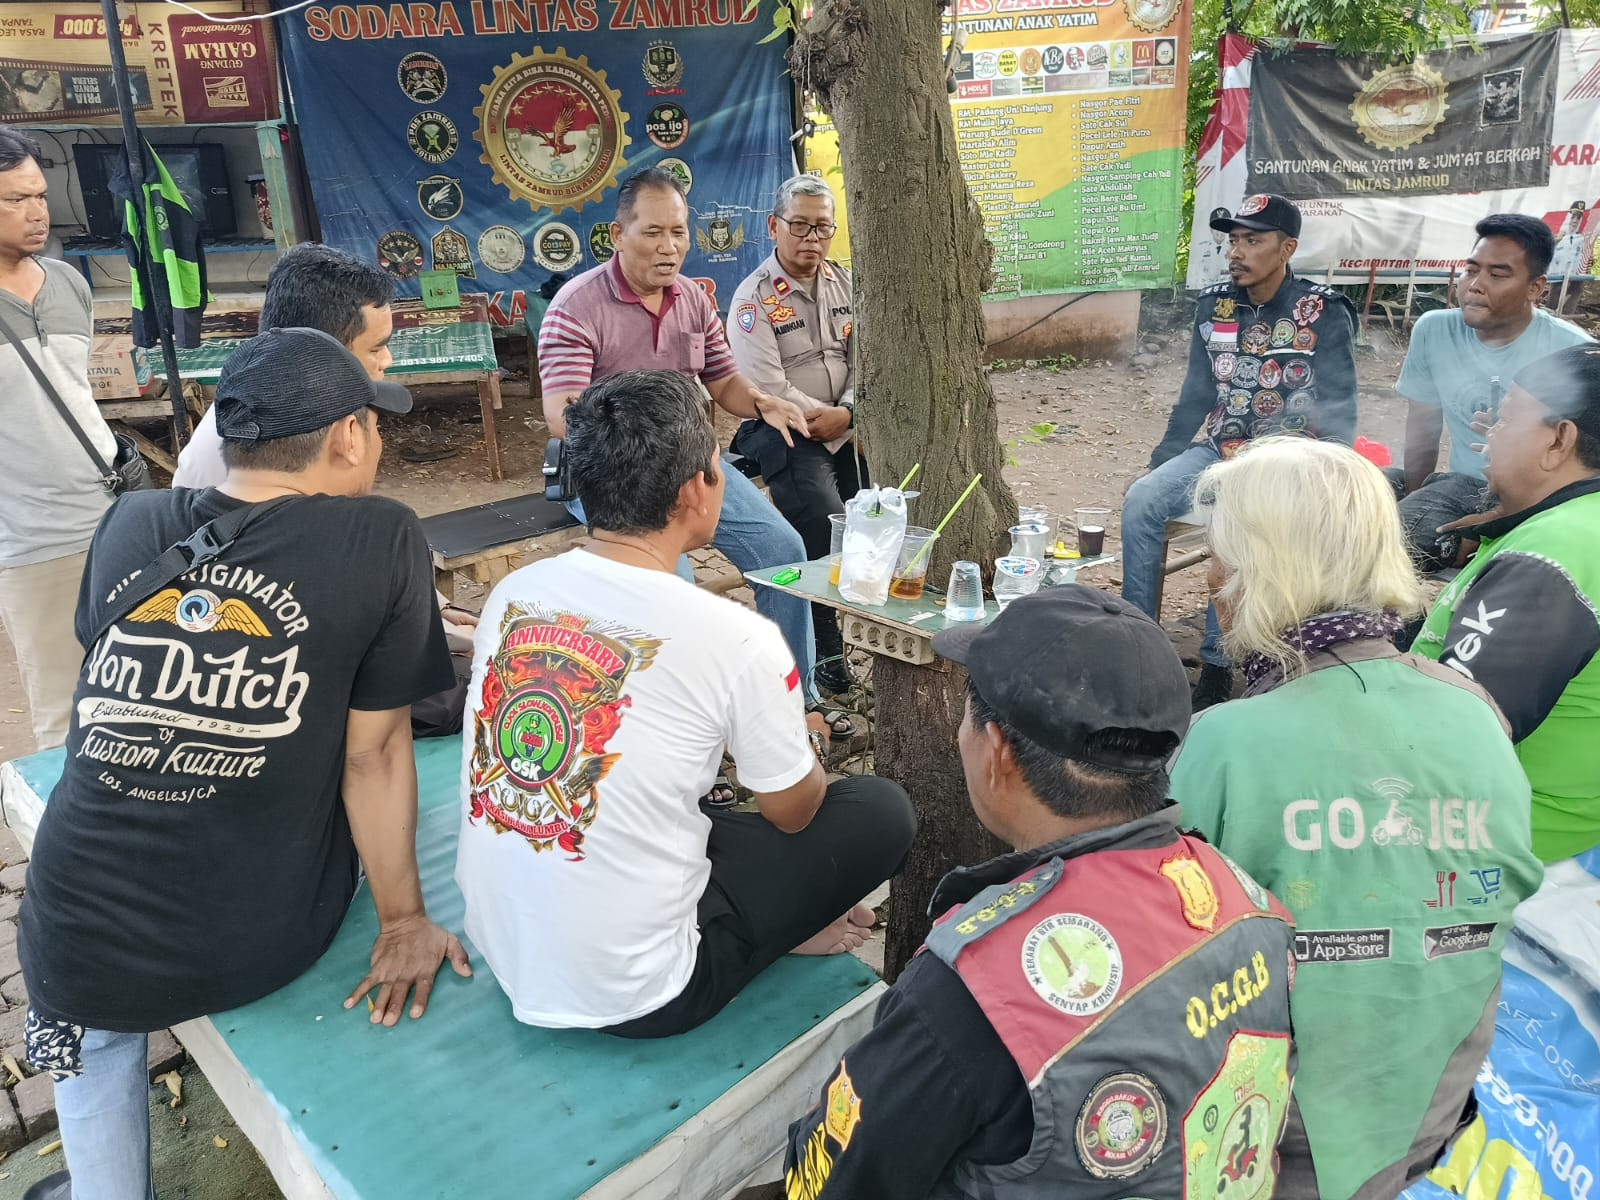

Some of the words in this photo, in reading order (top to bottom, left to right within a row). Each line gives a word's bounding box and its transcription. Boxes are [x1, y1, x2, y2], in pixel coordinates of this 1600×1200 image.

[2, 18, 34, 27] TANPA
[304, 2, 464, 41] SODARA
[472, 0, 599, 35] LINTAS
[608, 0, 758, 29] ZAMRUD
[1016, 15, 1055, 30] ANAK
[1056, 12, 1098, 28] YATIM
[20, 28, 45, 36] RASA
[181, 23, 253, 38] International
[183, 42, 257, 60] GARAM
[148, 23, 179, 118] KRETEK
[200, 60, 243, 68] GUDANG
[72, 77, 98, 85] SELERA
[73, 84, 99, 92] PUNYA
[74, 93, 102, 104] PRIA
[646, 122, 666, 133] pos
[668, 121, 682, 132] ijo
[960, 152, 978, 160] Soto
[988, 160, 1010, 169] Steak
[1254, 159, 1330, 174] SANTUNAN
[1332, 158, 1369, 174] ANAK
[1371, 156, 1414, 173] YATIM
[1417, 156, 1431, 170] &
[1433, 152, 1483, 170] JUM'AT
[1486, 146, 1542, 165] BERKAH
[500, 154, 526, 184] LINTAS
[526, 180, 564, 196] ZAMRUD
[1345, 177, 1391, 191] LINTAS
[1393, 174, 1450, 190] JAMRUD
[1339, 258, 1410, 268] KECAMATAN
[178, 562, 310, 638] RIGINATOR
[506, 625, 626, 676] ANNIVERSARY
[151, 635, 310, 709] Dutch
[90, 702, 192, 724] Established
[510, 756, 543, 782] OSK
[127, 785, 217, 804] ANGELES/CA
[1282, 796, 1366, 850] GO
[1428, 798, 1494, 850] JEK
[1056, 918, 1108, 943] SEMARANG
[1312, 934, 1356, 945] Available
[1356, 934, 1369, 943] on
[1369, 933, 1385, 942] the
[1440, 931, 1472, 950] Google
[1313, 944, 1346, 960] App
[1349, 942, 1385, 957] Store
[1048, 992, 1089, 1012] SENYAP
